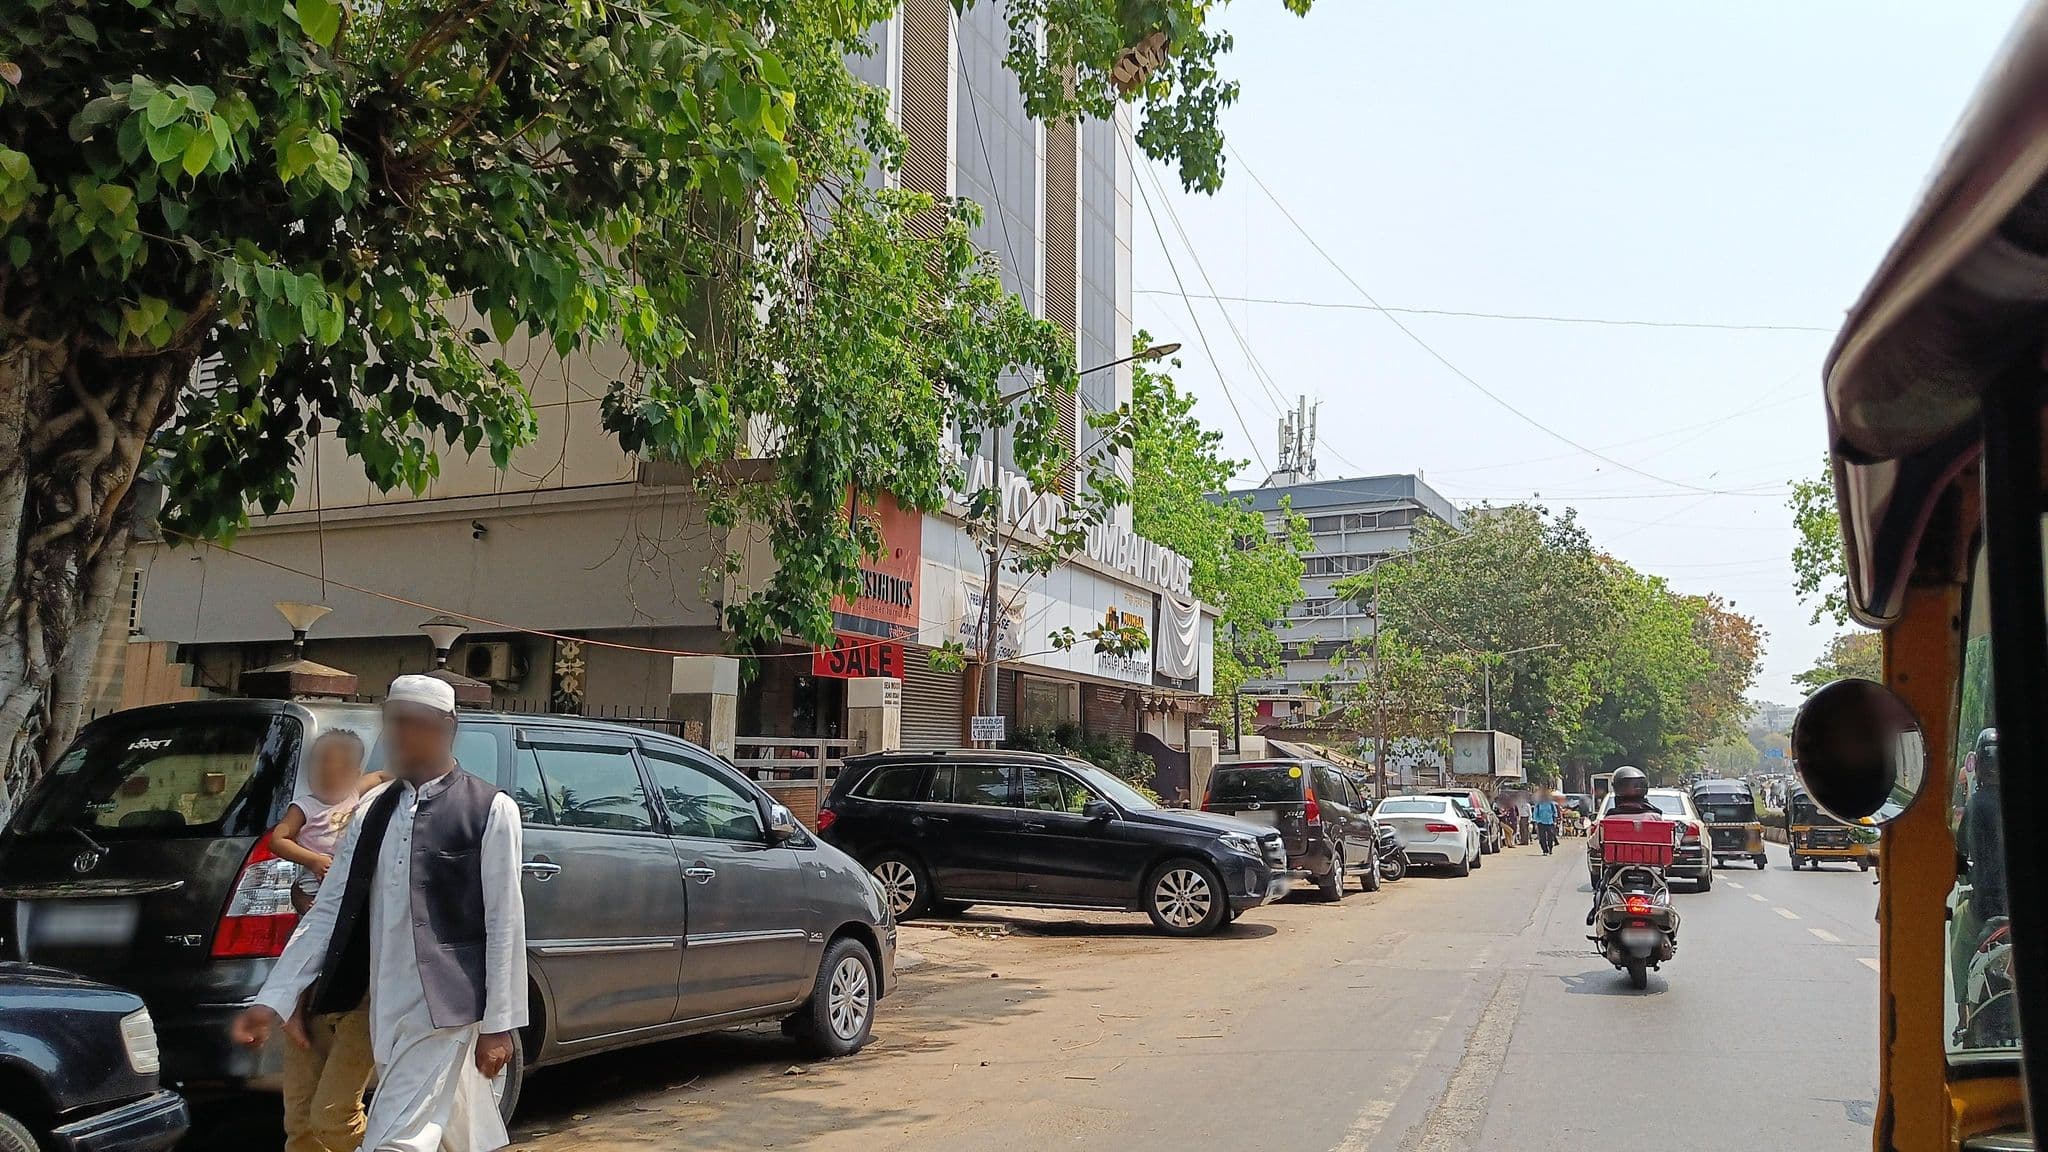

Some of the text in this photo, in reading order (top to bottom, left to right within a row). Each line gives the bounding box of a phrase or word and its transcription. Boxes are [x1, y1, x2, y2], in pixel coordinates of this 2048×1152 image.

[1146, 540, 1193, 598] HOUSE
[829, 636, 893, 677] SALE
[1123, 656, 1151, 675] Banquet
